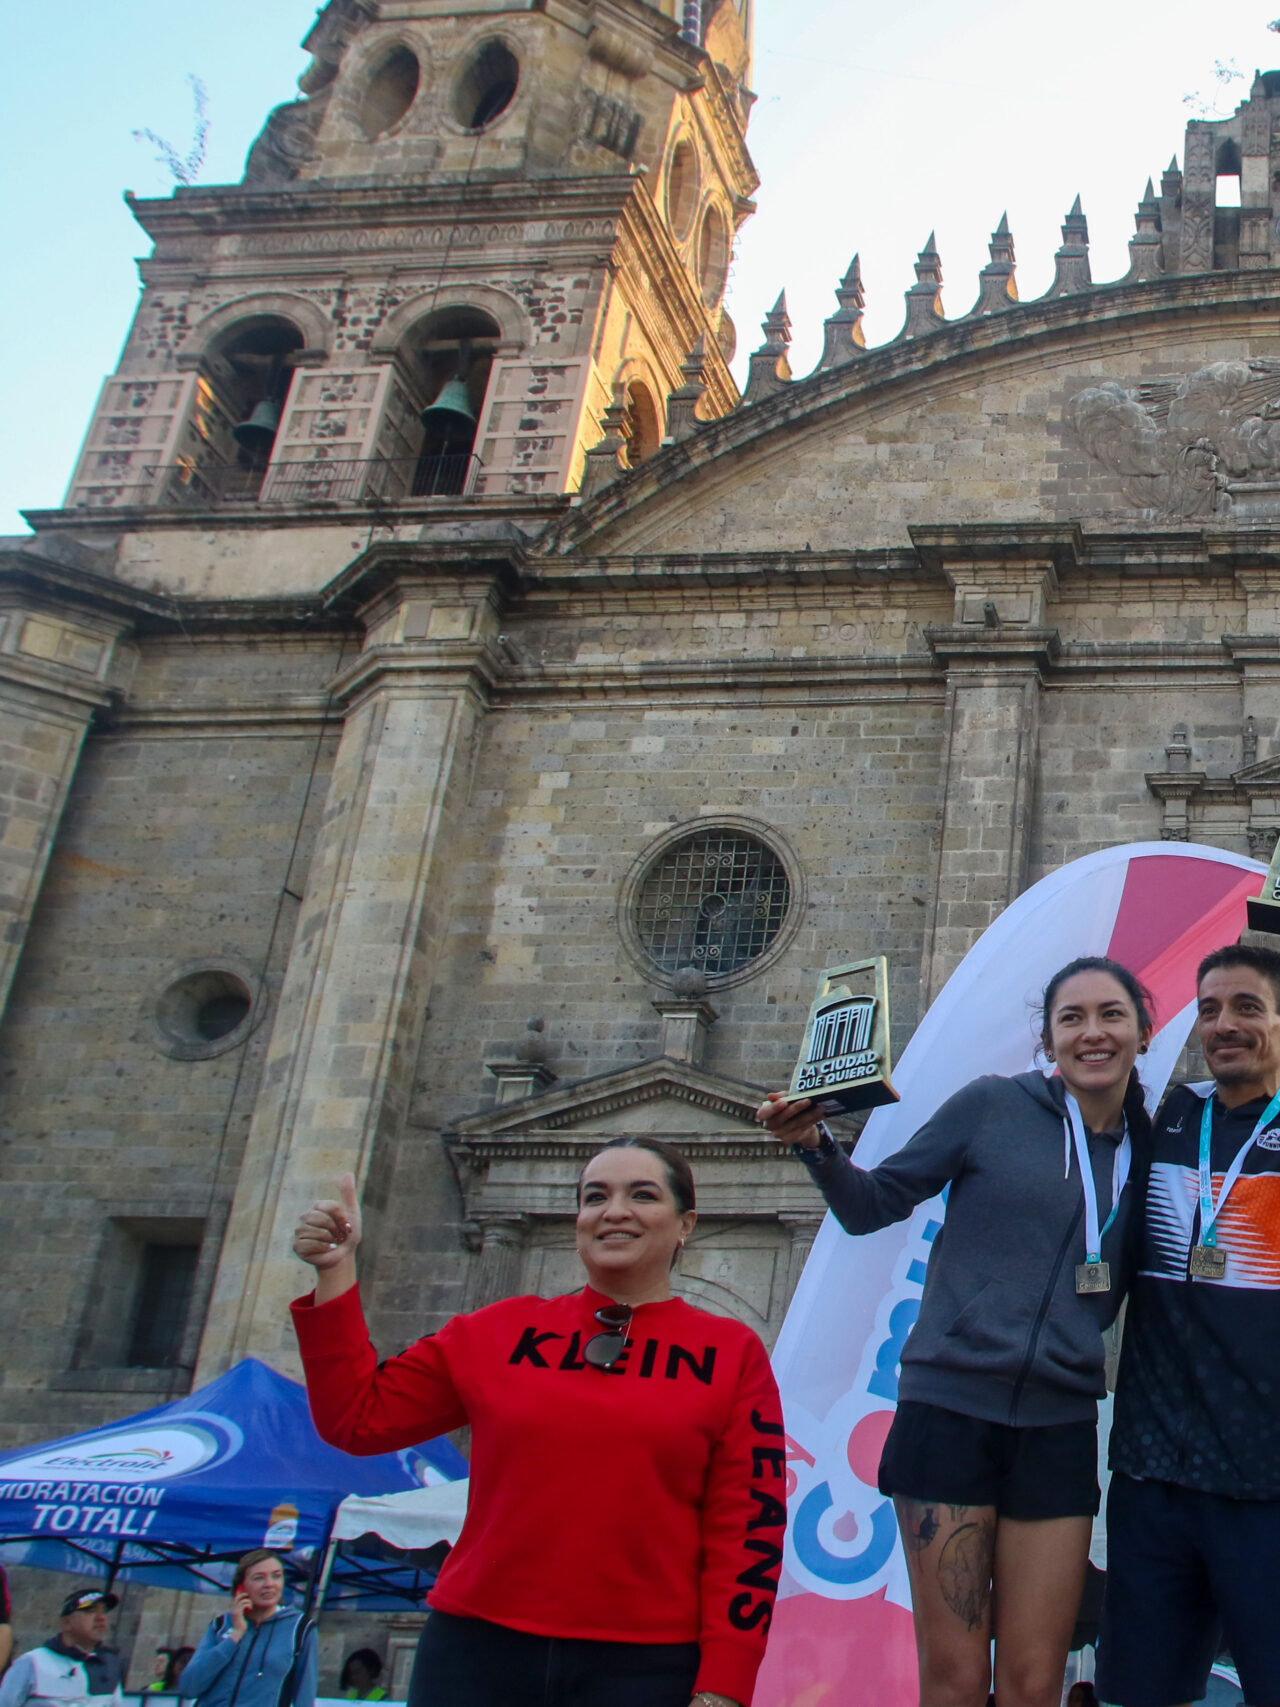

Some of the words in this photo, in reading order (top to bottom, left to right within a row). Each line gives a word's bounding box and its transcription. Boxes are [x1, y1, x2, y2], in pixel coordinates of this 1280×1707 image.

[796, 1076, 822, 1091] QUE
[825, 1063, 876, 1084] QUIERO
[799, 1065, 816, 1079] LA
[821, 1051, 878, 1074] CIUDAD
[32, 1504, 157, 1535] TOTAL!
[728, 1408, 787, 1637] JEANS
